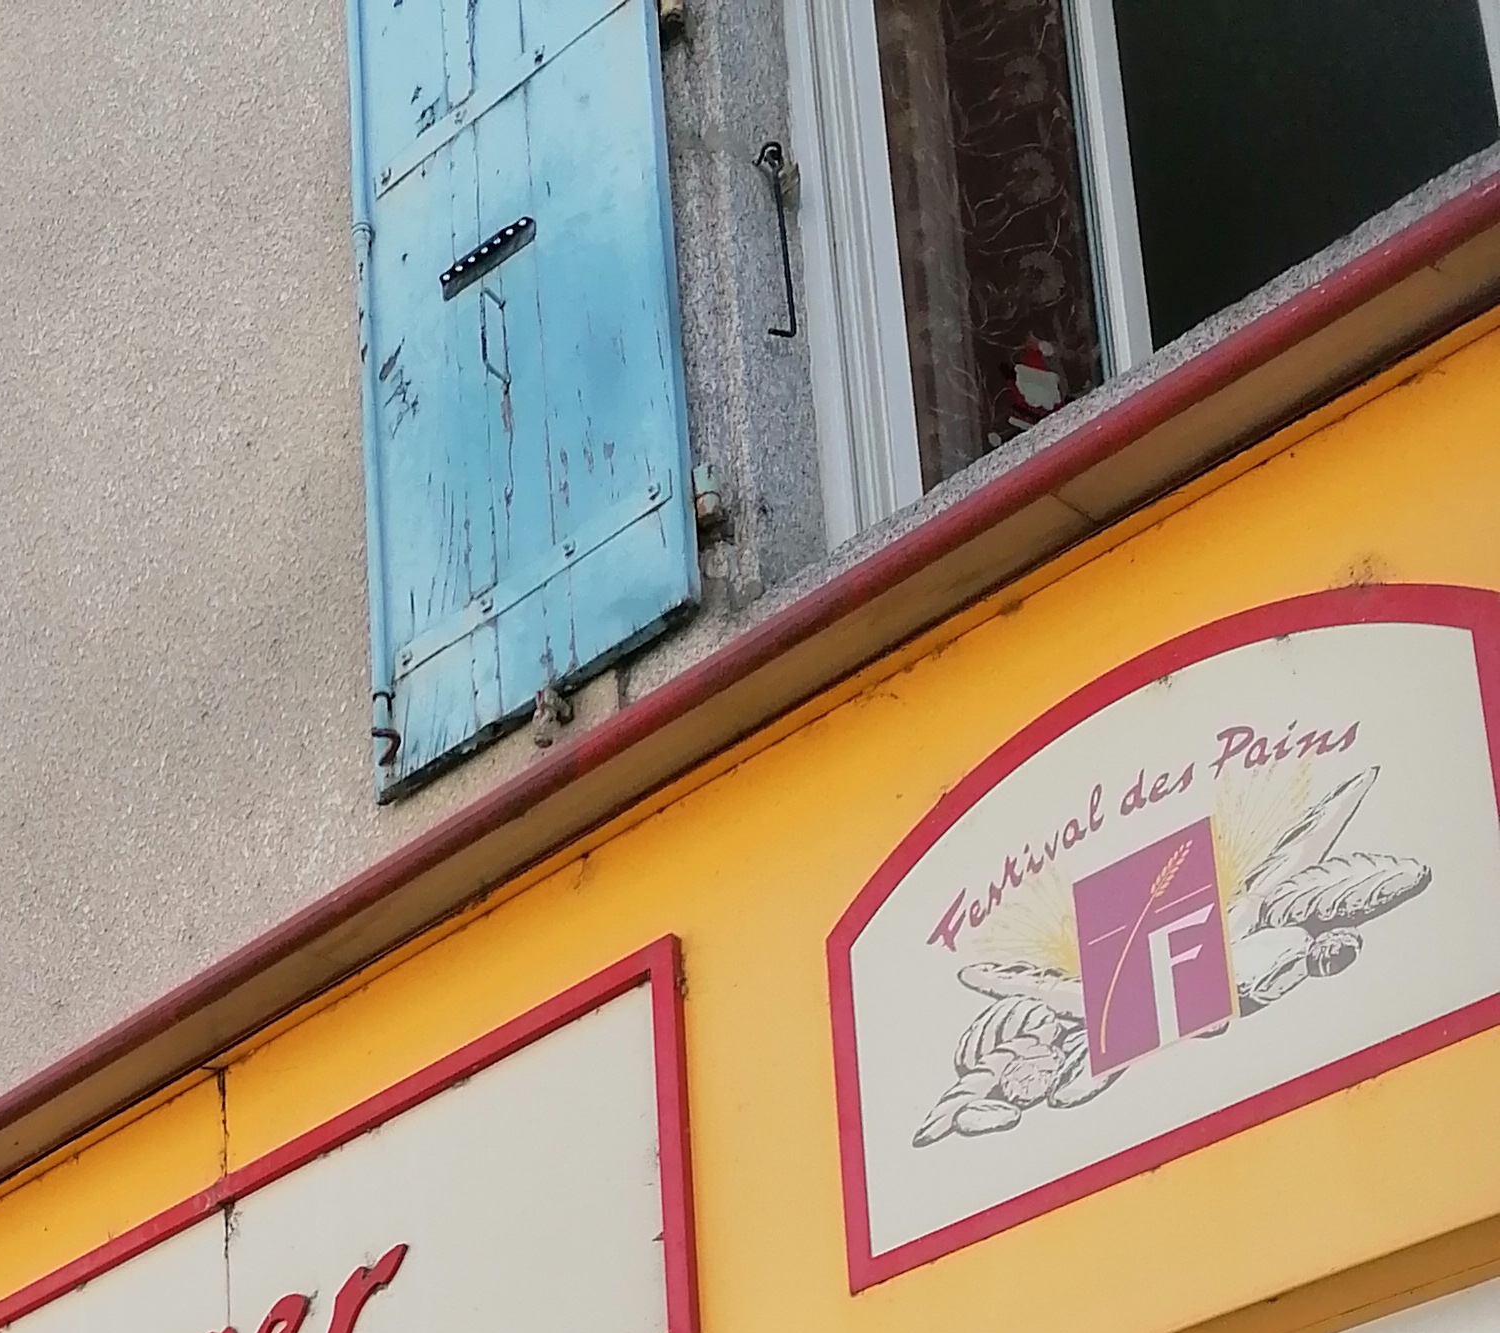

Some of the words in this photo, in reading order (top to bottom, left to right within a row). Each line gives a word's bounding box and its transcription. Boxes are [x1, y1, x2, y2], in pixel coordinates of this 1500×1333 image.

[927, 784, 1104, 951] Festival
[1120, 763, 1194, 818] des
[1210, 720, 1360, 780] Pains
